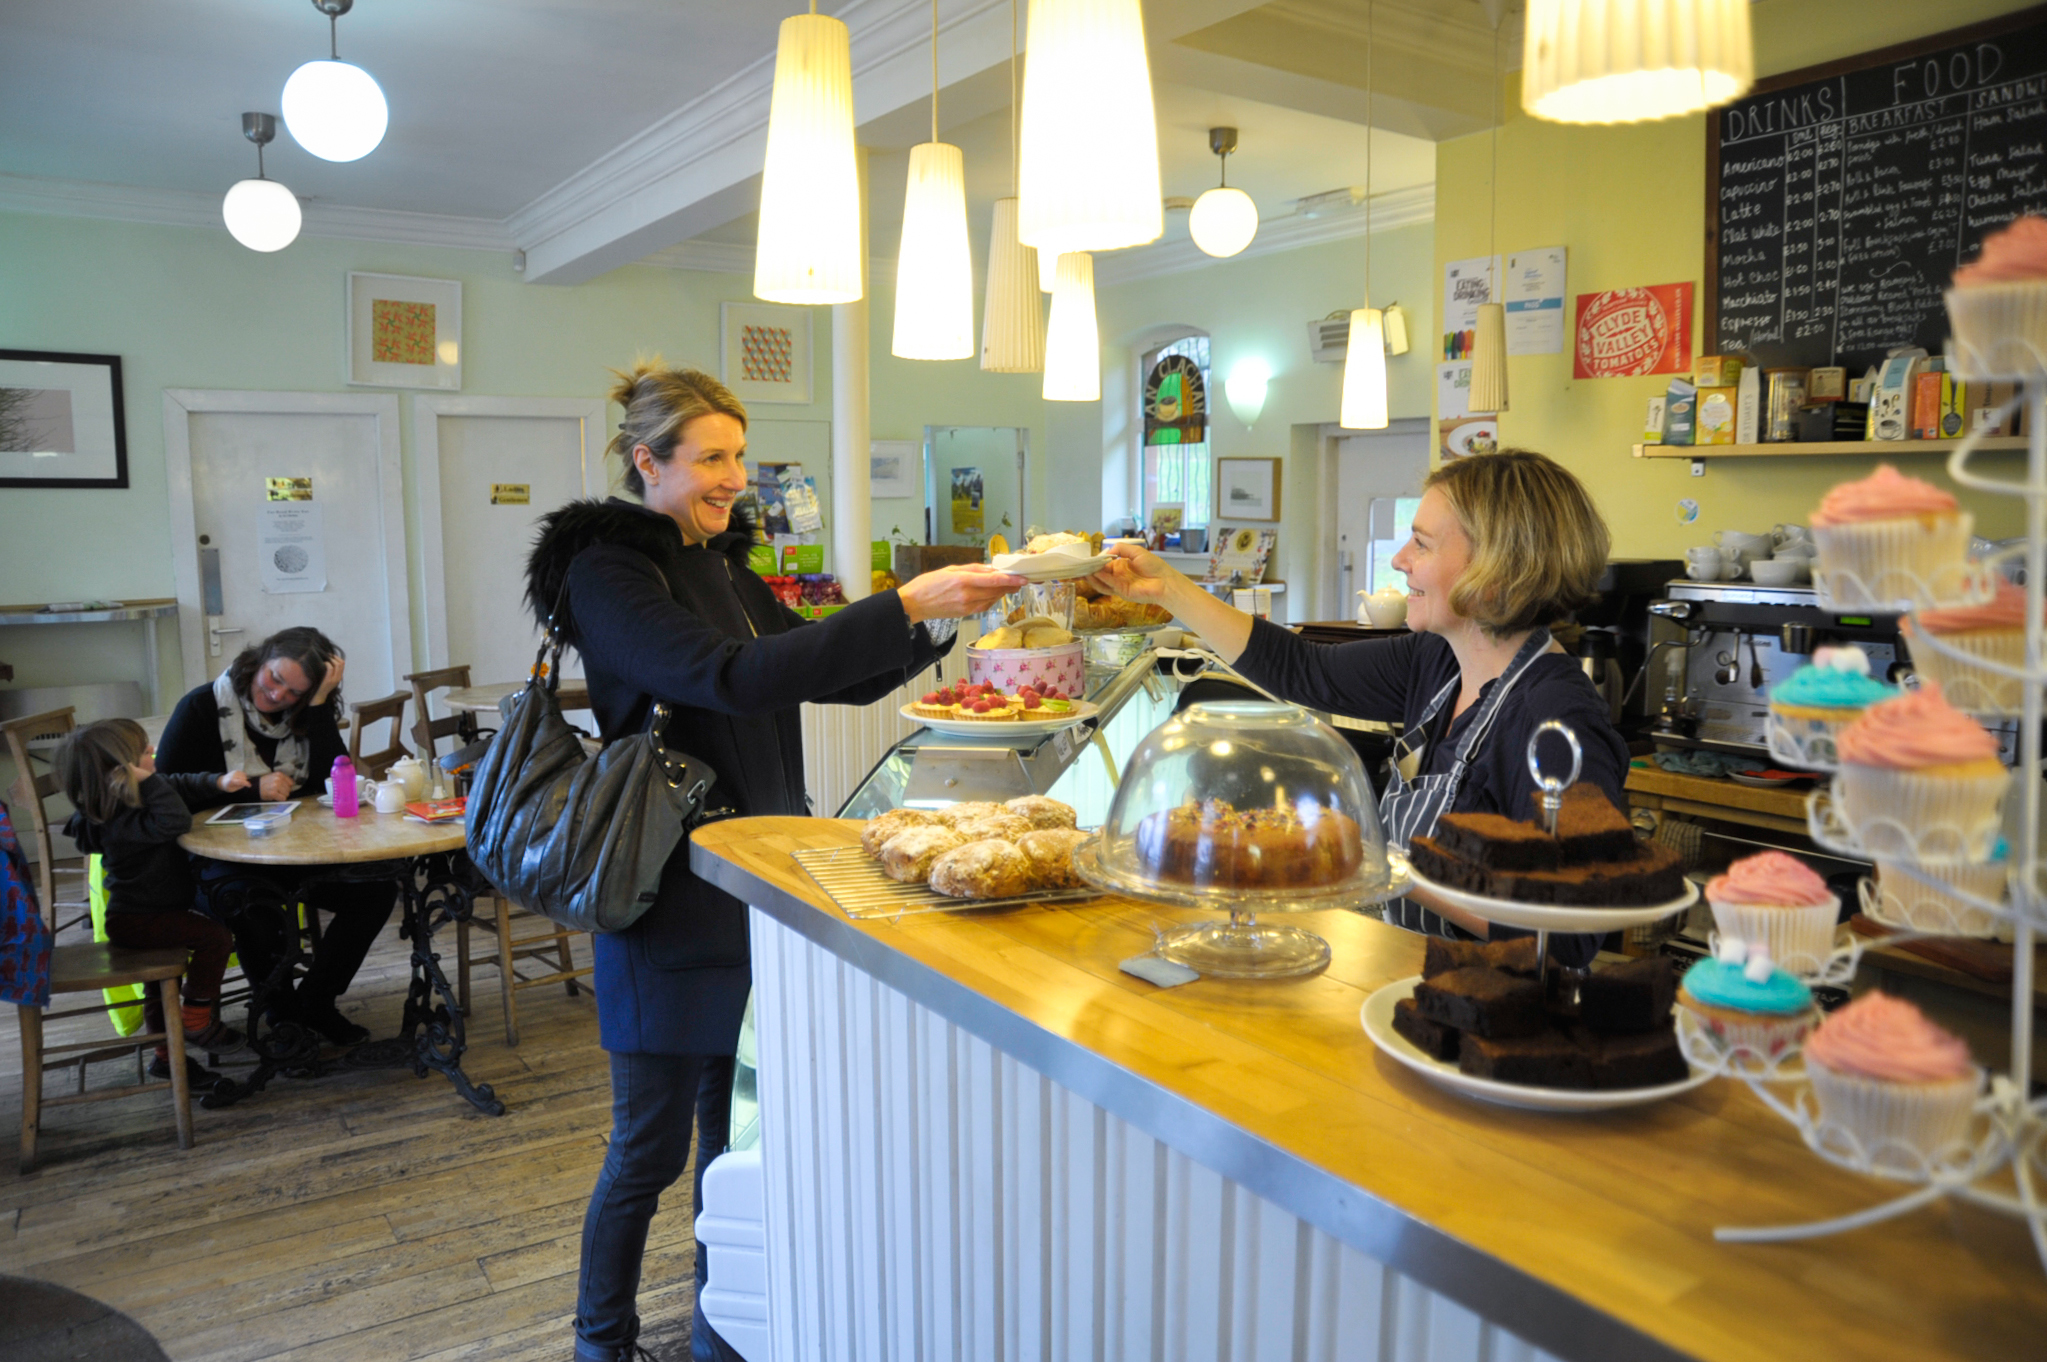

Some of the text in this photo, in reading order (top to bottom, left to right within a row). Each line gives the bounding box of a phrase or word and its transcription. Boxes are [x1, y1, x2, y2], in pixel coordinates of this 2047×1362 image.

[1893, 43, 2001, 105] FOOD
[1728, 87, 1834, 141] DRINKS
[1973, 115, 2002, 131] Ham
[1723, 155, 1785, 178] Americano
[1968, 174, 1992, 190] Egg
[1967, 192, 2007, 209] Cheese
[1722, 201, 1762, 224] Latte
[1722, 248, 1766, 269] Mocha
[1722, 270, 1780, 289] Hot Choc
[1722, 289, 1778, 310] Macchiato
[1596, 310, 1642, 337] CLYDE
[1720, 315, 1773, 333] Espresso
[1596, 325, 1651, 355] VALLEY
[1720, 339, 1747, 352] Tea
[1593, 338, 1659, 369] TOMATOES
[1145, 358, 1205, 416] AN CLACHAN
